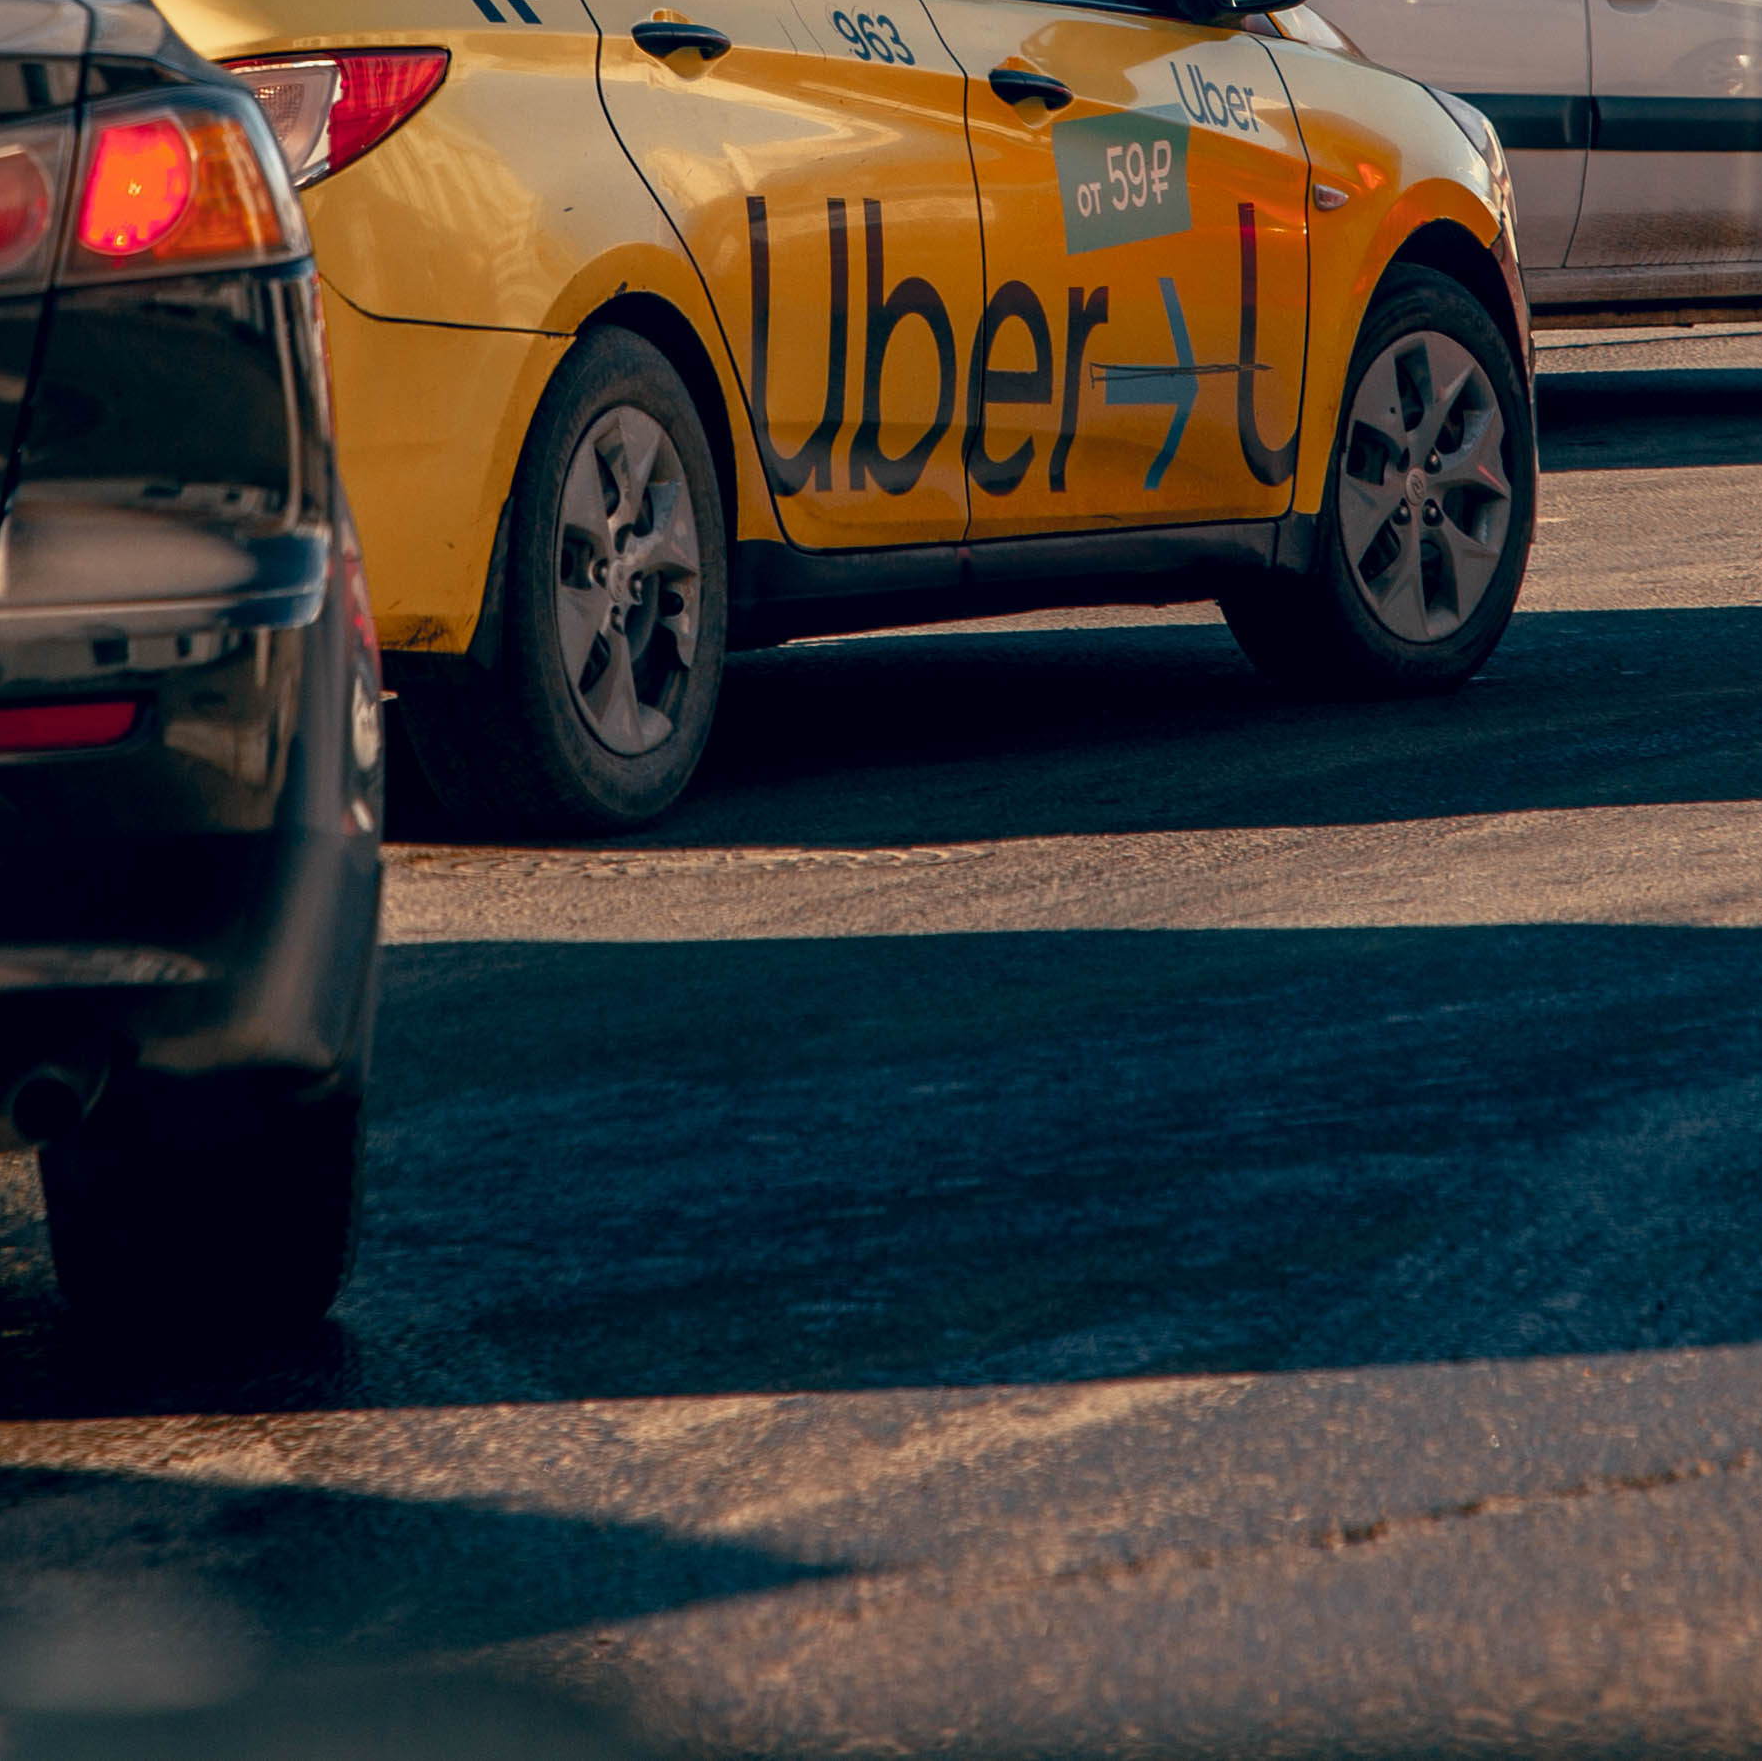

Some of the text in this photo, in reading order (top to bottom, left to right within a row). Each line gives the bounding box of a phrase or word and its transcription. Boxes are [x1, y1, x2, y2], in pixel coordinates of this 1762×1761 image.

[832, 10, 916, 66] 963
[1169, 61, 1260, 134] Uber
[1076, 181, 1103, 220] от
[746, 195, 1109, 497] Uber
